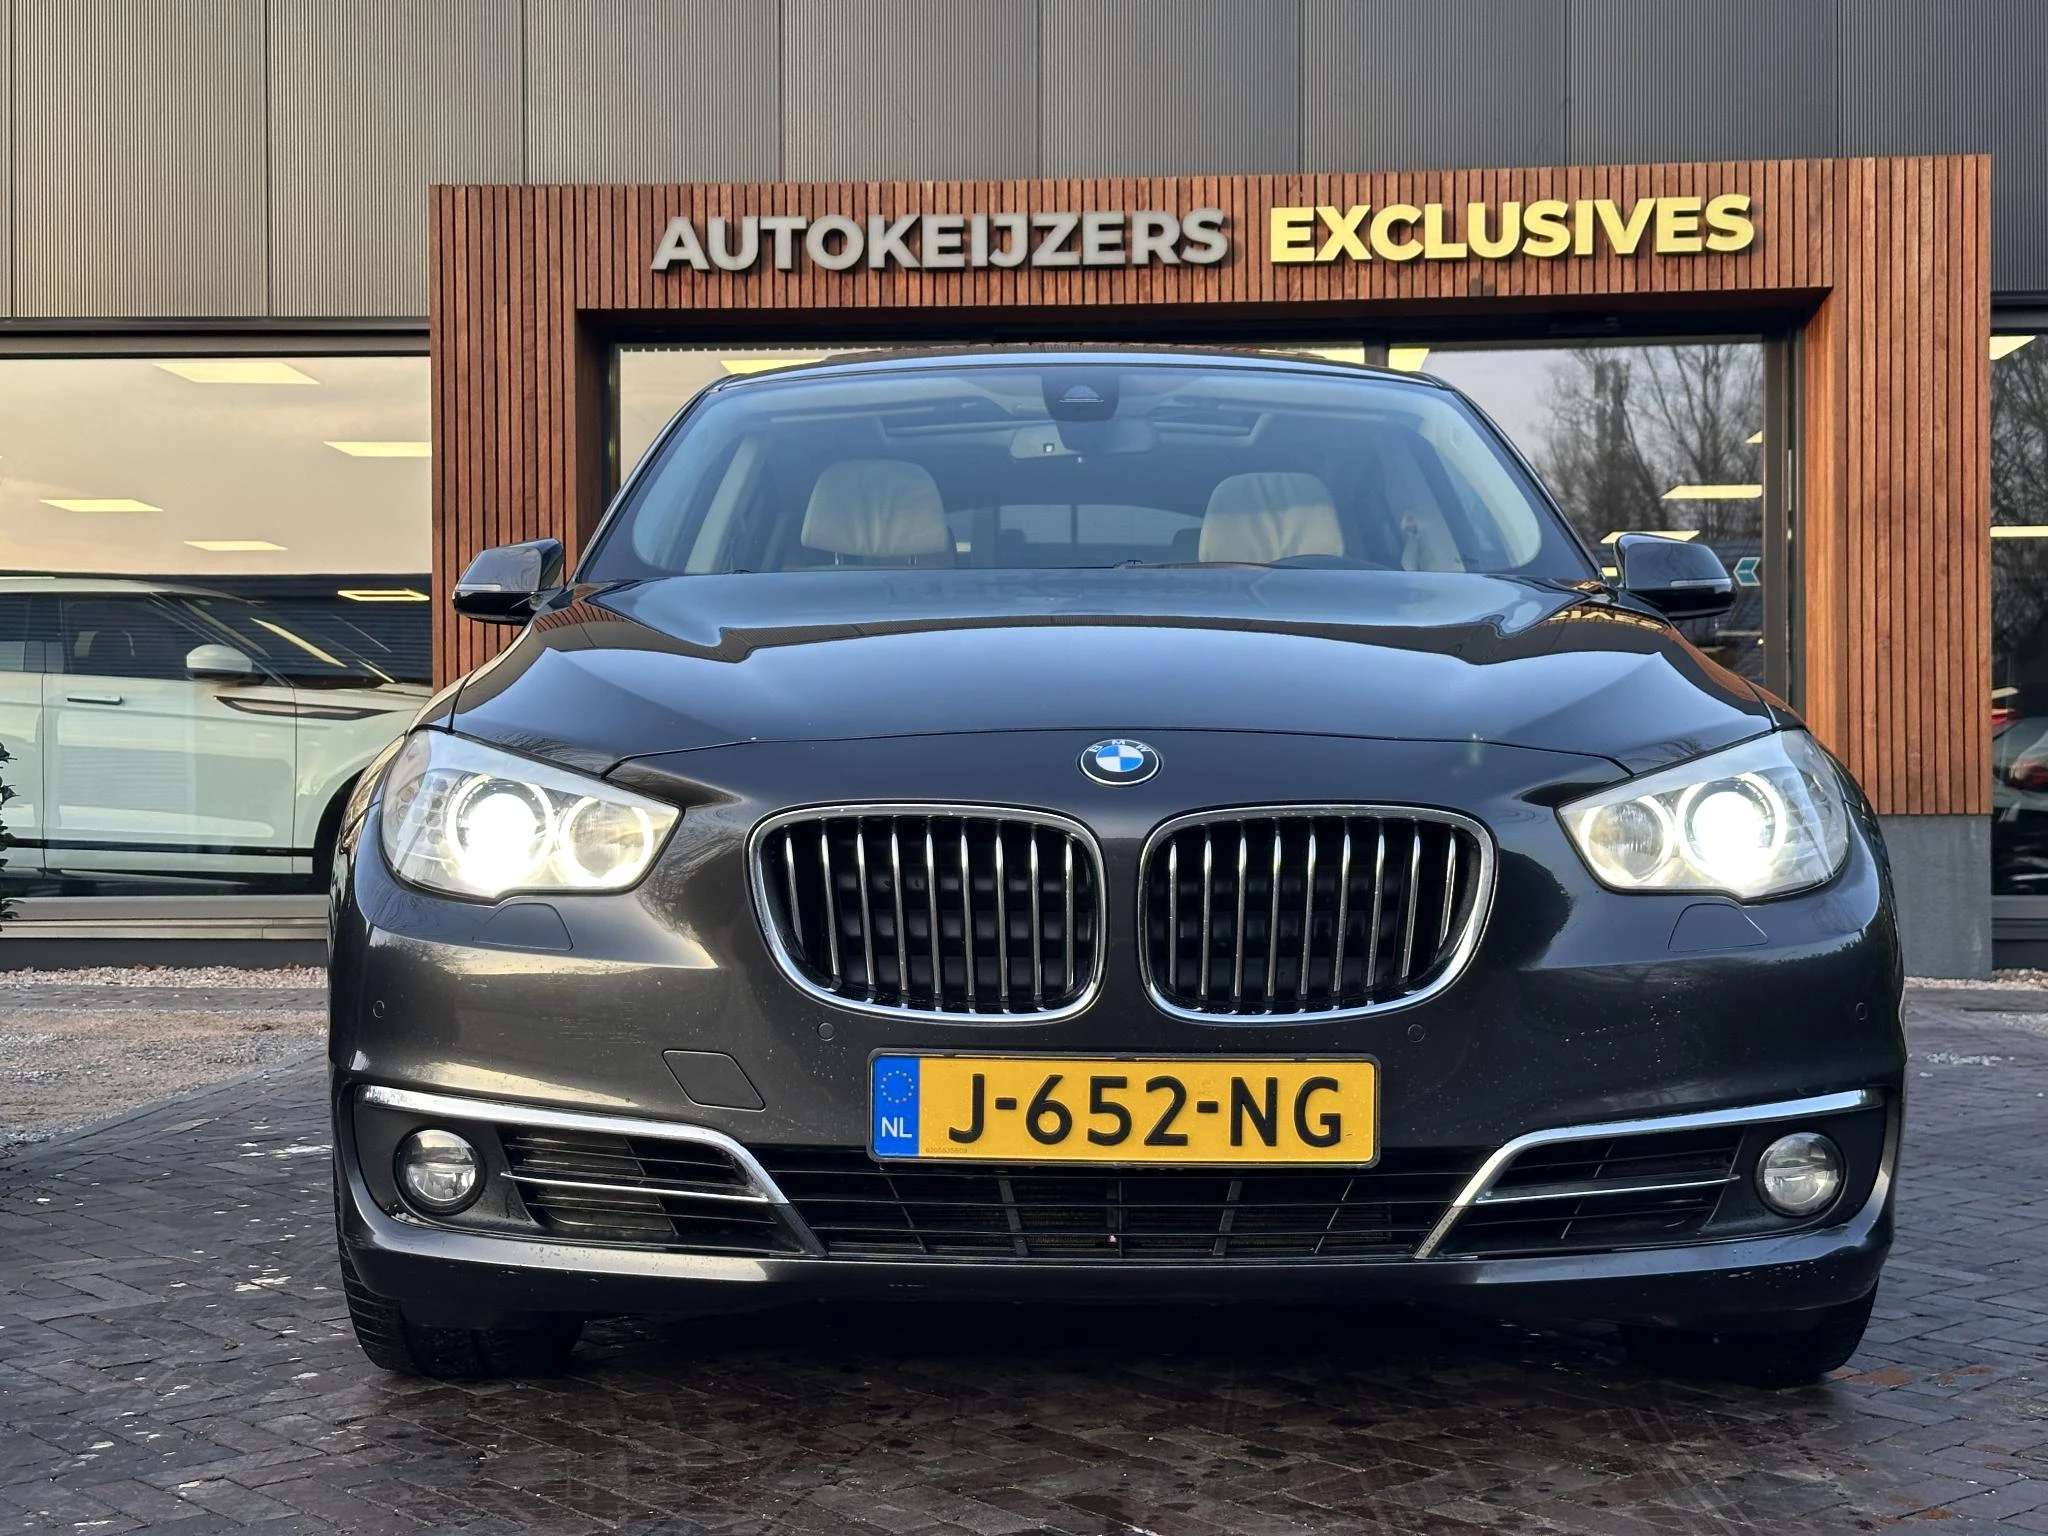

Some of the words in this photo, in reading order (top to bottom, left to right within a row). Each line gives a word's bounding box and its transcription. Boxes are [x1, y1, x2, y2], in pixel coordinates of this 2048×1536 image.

[651, 208, 1229, 271] AUTOKEIJZERS
[1270, 194, 1755, 264] EXCLUSIVES
[1088, 739, 1152, 752] BMW
[881, 1117, 912, 1138] NL
[948, 1073, 1342, 1147] J-652-NG
